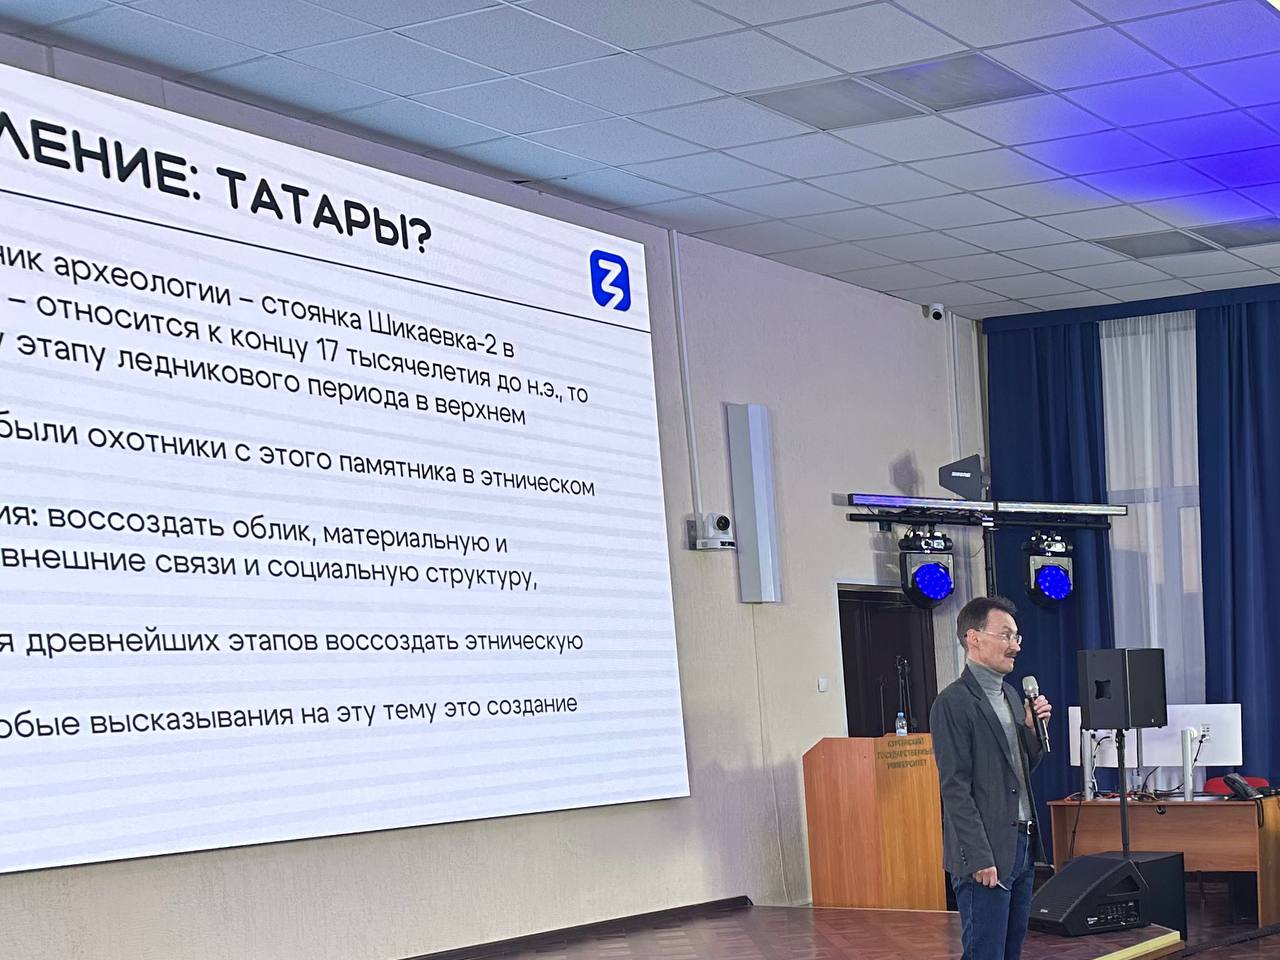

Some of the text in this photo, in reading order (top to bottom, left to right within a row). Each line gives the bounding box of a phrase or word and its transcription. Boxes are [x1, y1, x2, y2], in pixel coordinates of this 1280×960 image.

[215, 166, 432, 254] ТАТАРЫ?
[54, 256, 232, 306] археологии
[261, 295, 362, 331] стоянка
[368, 309, 498, 356] Шикаевка-2
[502, 341, 515, 359] в
[16, 334, 106, 372] этапу
[118, 350, 300, 392] ледникового
[307, 377, 410, 411] периода
[415, 394, 429, 411] в
[434, 396, 526, 426] верхнем
[37, 296, 200, 340] относится
[207, 324, 223, 344] к
[231, 331, 308, 362] концу
[316, 337, 339, 362] 17
[346, 347, 491, 388] тысячелетия
[496, 373, 522, 394] до
[566, 385, 589, 404] то
[87, 427, 227, 460] охотники
[234, 443, 251, 462] с
[259, 445, 332, 470] этого
[339, 454, 457, 483] памятника
[462, 468, 475, 484] в
[480, 469, 595, 497] этническом
[47, 508, 225, 538] воссоздать
[232, 514, 317, 547] облик,
[323, 526, 490, 557] материальную
[495, 537, 508, 553] и
[0, 547, 537, 592] внешние связи и социальную структуру,
[25, 625, 221, 660] древнейших
[228, 633, 319, 652] этапов
[325, 633, 459, 654] воссоздать
[464, 634, 584, 655] этническую
[90, 708, 294, 734] высказывания
[301, 706, 330, 724] на
[336, 704, 376, 727] эту
[382, 702, 437, 724] тему
[444, 700, 481, 718] это
[486, 697, 578, 717] создание
